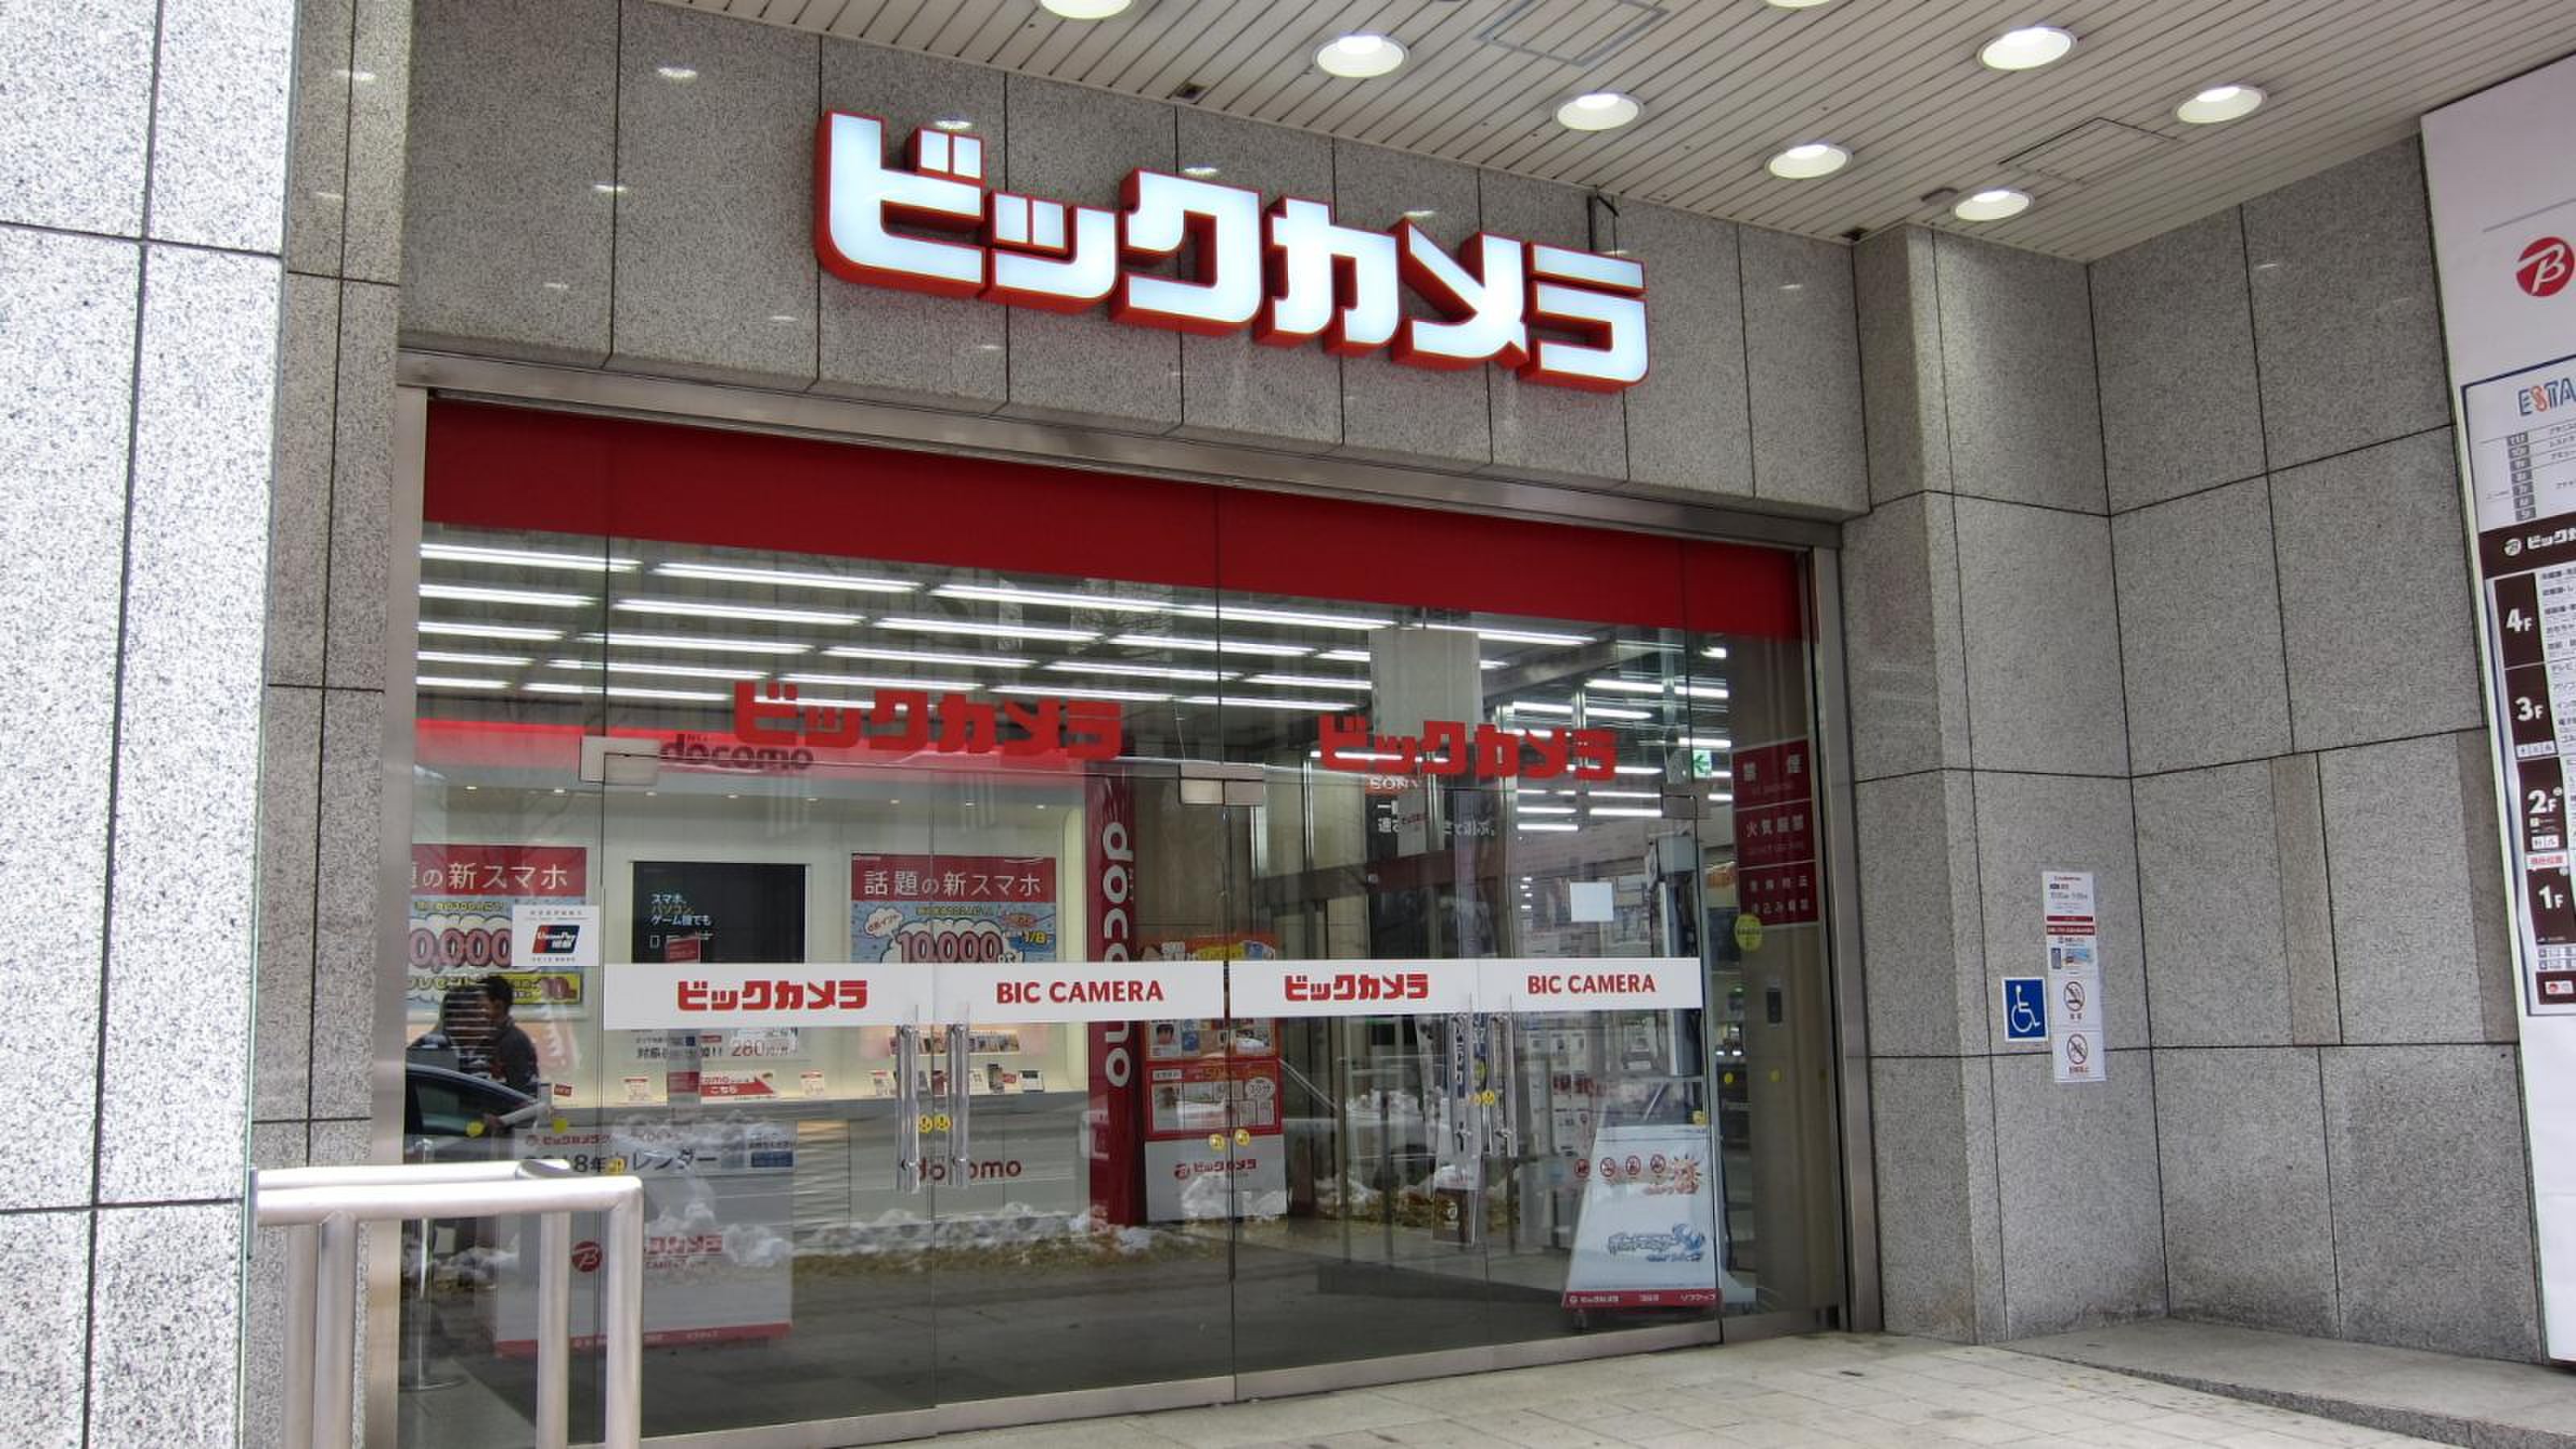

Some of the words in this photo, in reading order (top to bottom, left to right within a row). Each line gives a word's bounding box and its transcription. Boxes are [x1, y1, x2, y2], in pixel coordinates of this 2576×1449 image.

[817, 112, 1649, 392] ビックカメラ
[2506, 608, 2533, 633] 4F
[734, 682, 1121, 759] ビックカメラ
[2515, 696, 2543, 721] 3F
[659, 733, 814, 770] docomo
[1319, 714, 1617, 781] ビックカメラ
[2528, 790, 2557, 814] 2F
[864, 870, 1042, 898] 話題の新スマホ
[2539, 886, 2564, 909] 1F
[677, 980, 868, 1011] ビックカメラ
[996, 980, 1041, 1004] BIC
[1048, 979, 1164, 1003] CAMERA
[1284, 973, 1430, 1001] ビックカメラ
[1527, 974, 1563, 994] BIC
[1567, 973, 1656, 993] CAMERA
